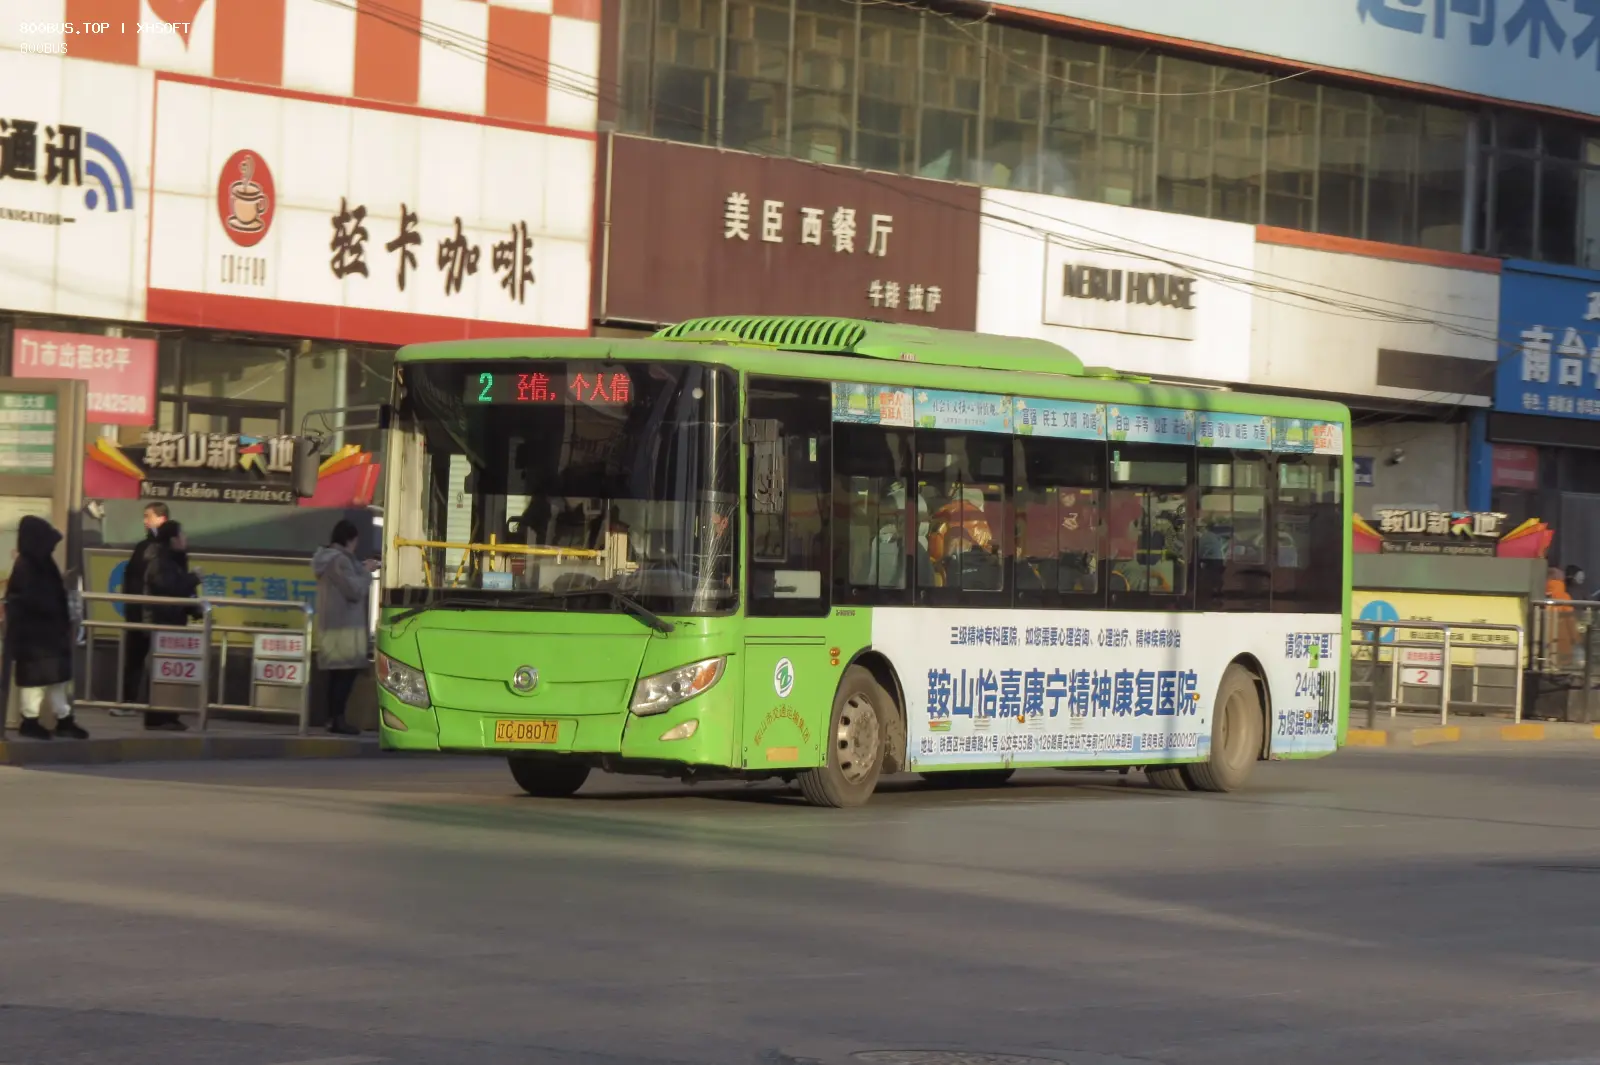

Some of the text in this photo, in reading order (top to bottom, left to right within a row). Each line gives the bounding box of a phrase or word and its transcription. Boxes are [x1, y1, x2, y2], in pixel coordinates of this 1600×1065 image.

[0, 118, 83, 187] 通讯
[724, 191, 893, 257] 美臣西餐厅
[330, 196, 535, 304] 轻卡咖啡
[1126, 271, 1197, 310] HOUSE
[478, 372, 493, 402] 2
[1043, 409, 1058, 427] 民主
[161, 661, 196, 678] 602
[263, 663, 297, 680] 602
[1416, 670, 1429, 684] 2
[927, 667, 1199, 719] 鞍山怡嘉康宁精神康复医院
